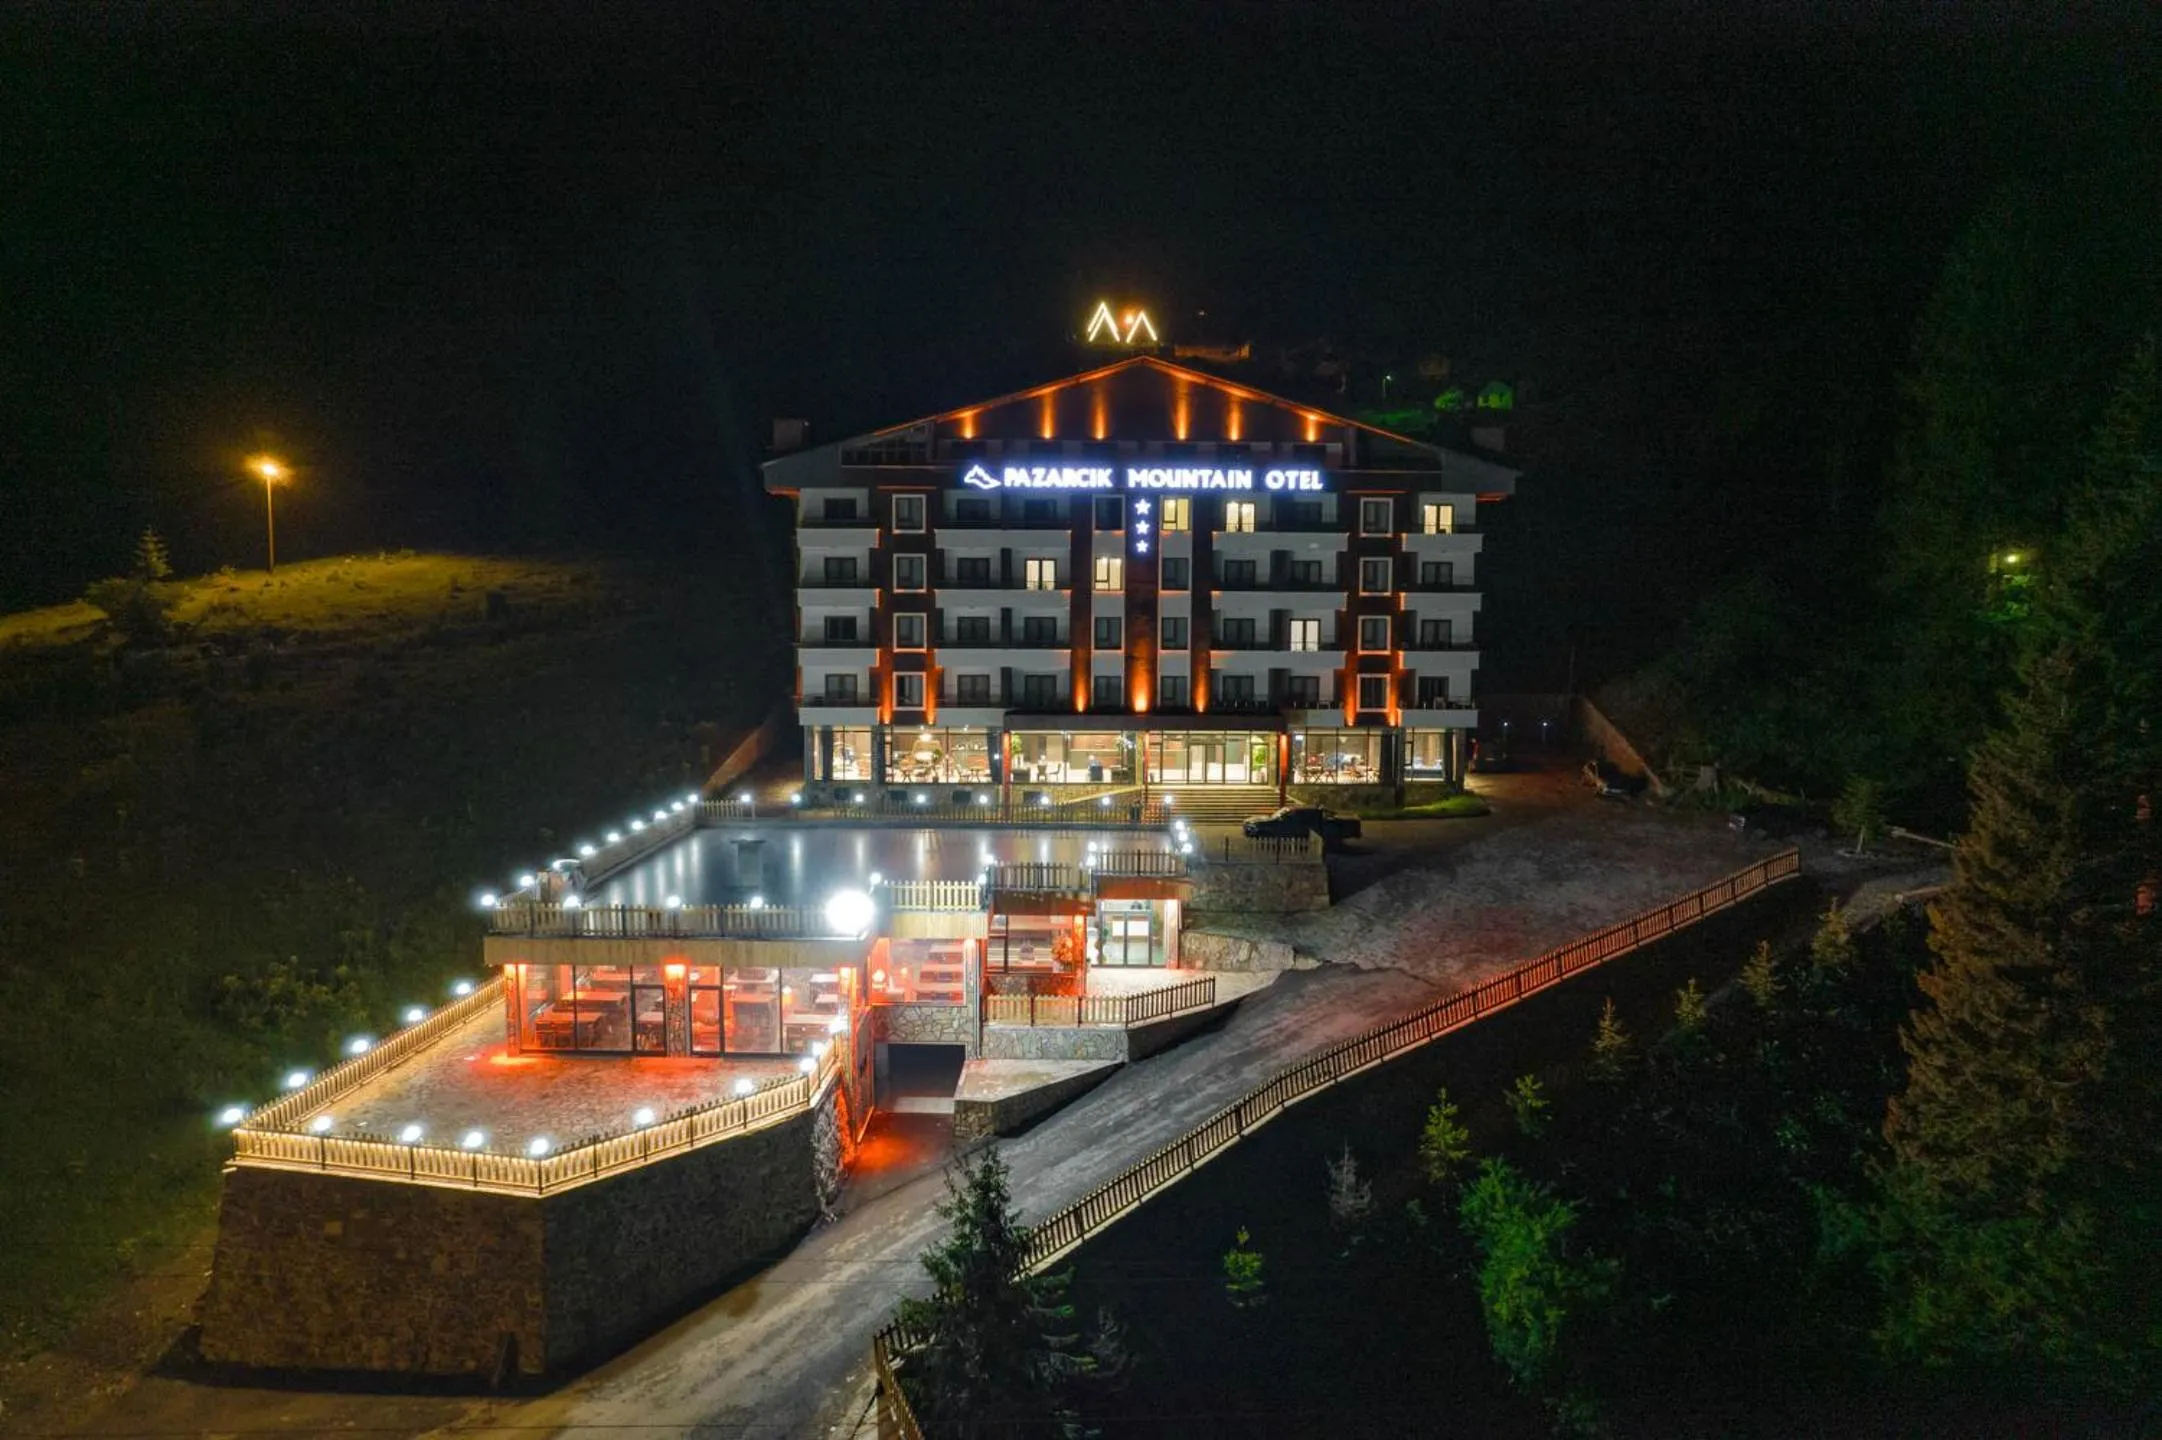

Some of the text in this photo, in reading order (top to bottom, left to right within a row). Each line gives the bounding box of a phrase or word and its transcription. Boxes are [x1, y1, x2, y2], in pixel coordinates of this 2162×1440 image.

[1003, 467, 1324, 490] PAZARCIK MOUNTAIN OTEL
